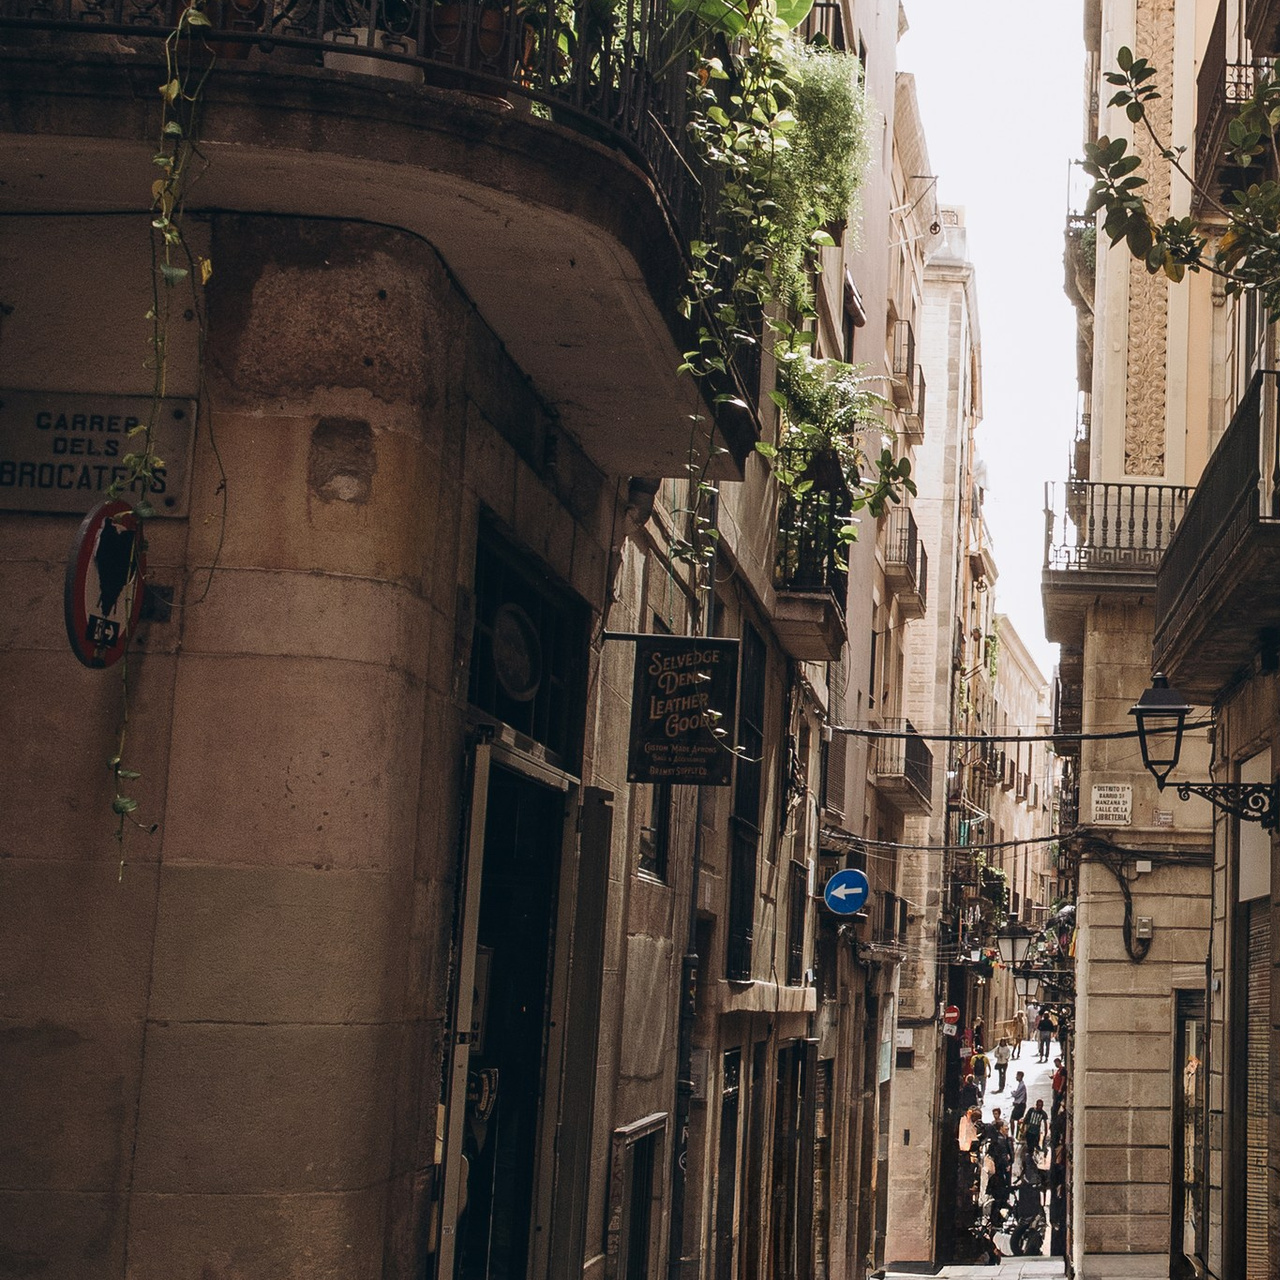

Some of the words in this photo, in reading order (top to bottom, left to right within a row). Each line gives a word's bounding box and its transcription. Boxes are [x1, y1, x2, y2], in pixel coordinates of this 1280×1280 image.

[35, 412, 140, 433] CARRER
[53, 437, 119, 457] DELS
[648, 650, 720, 675] SELVEDGE
[649, 692, 709, 719] LEATHER
